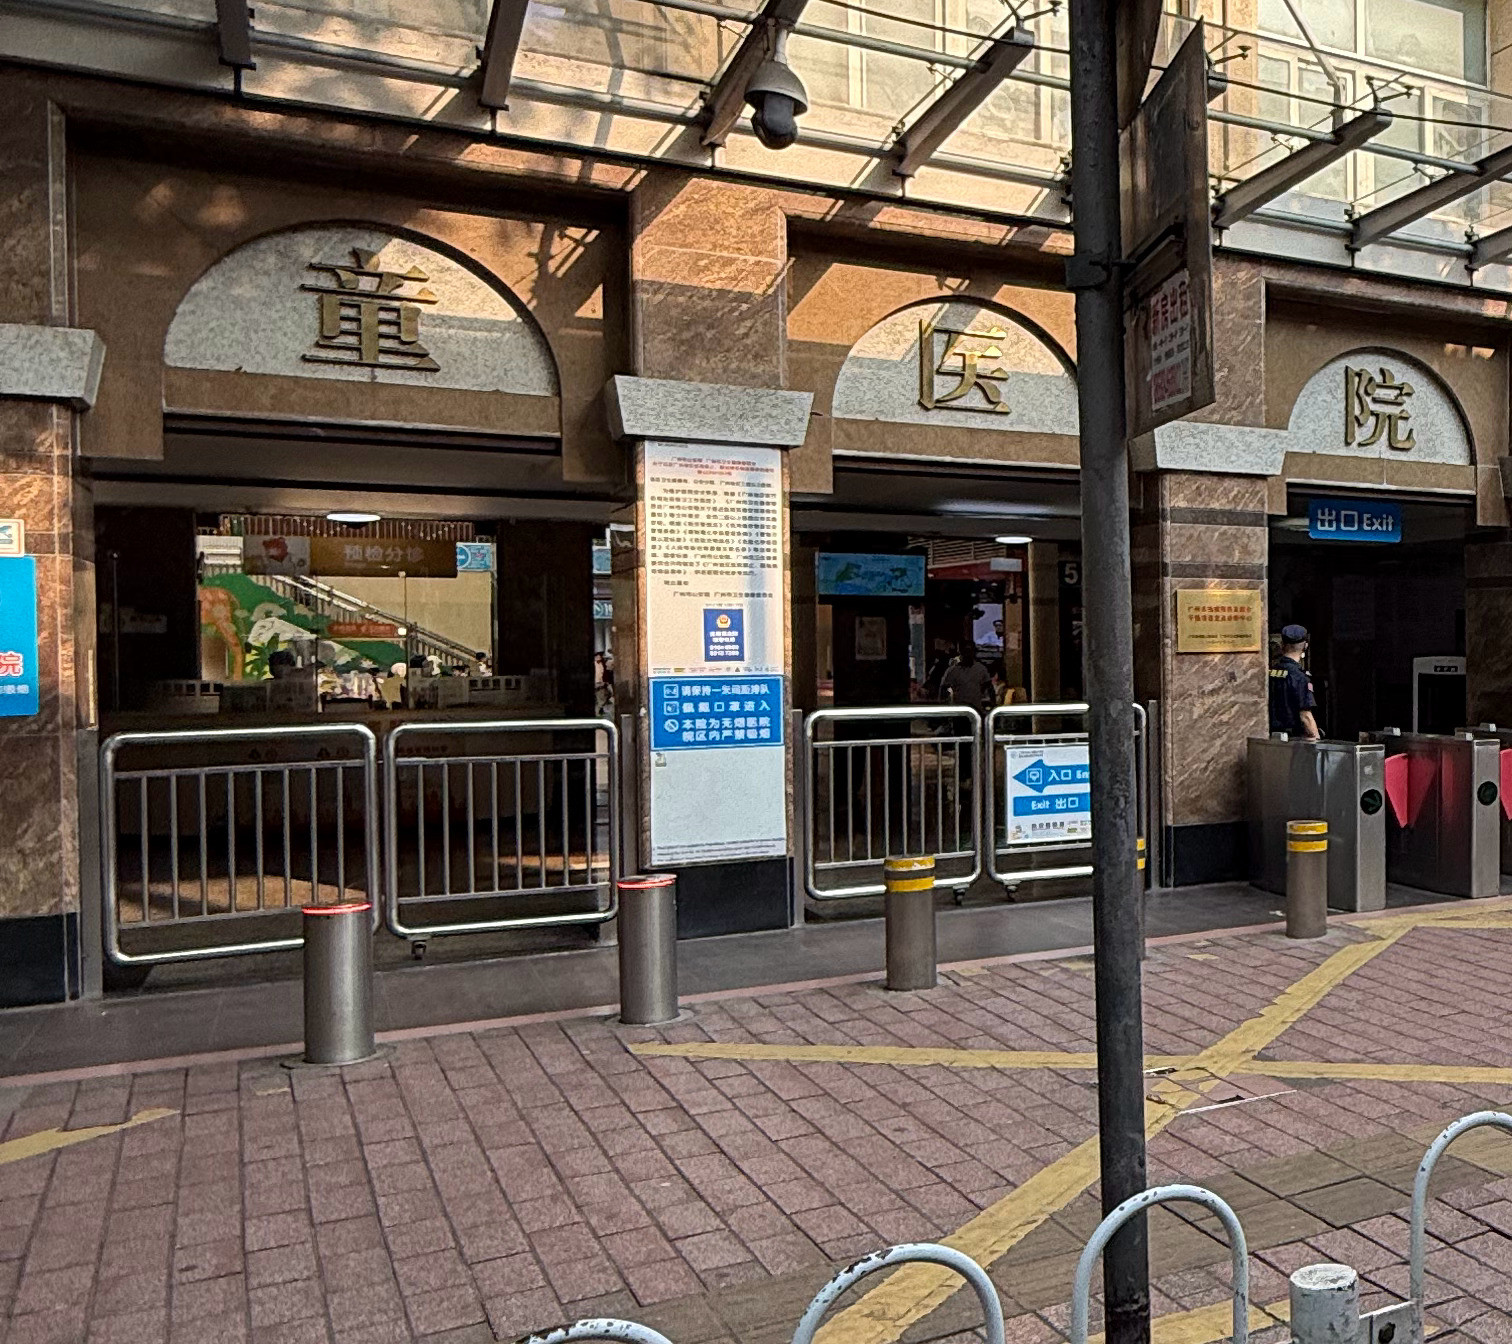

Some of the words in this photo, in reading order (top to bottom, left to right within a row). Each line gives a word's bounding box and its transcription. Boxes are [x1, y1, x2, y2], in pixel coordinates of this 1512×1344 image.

[1317, 507, 1359, 531] 出口
[1362, 513, 1394, 532] Exit
[682, 717, 771, 729] 本院为无烟医院
[1047, 769, 1072, 782] 入口
[1031, 800, 1050, 810] Exit
[1055, 797, 1079, 810] 出口
